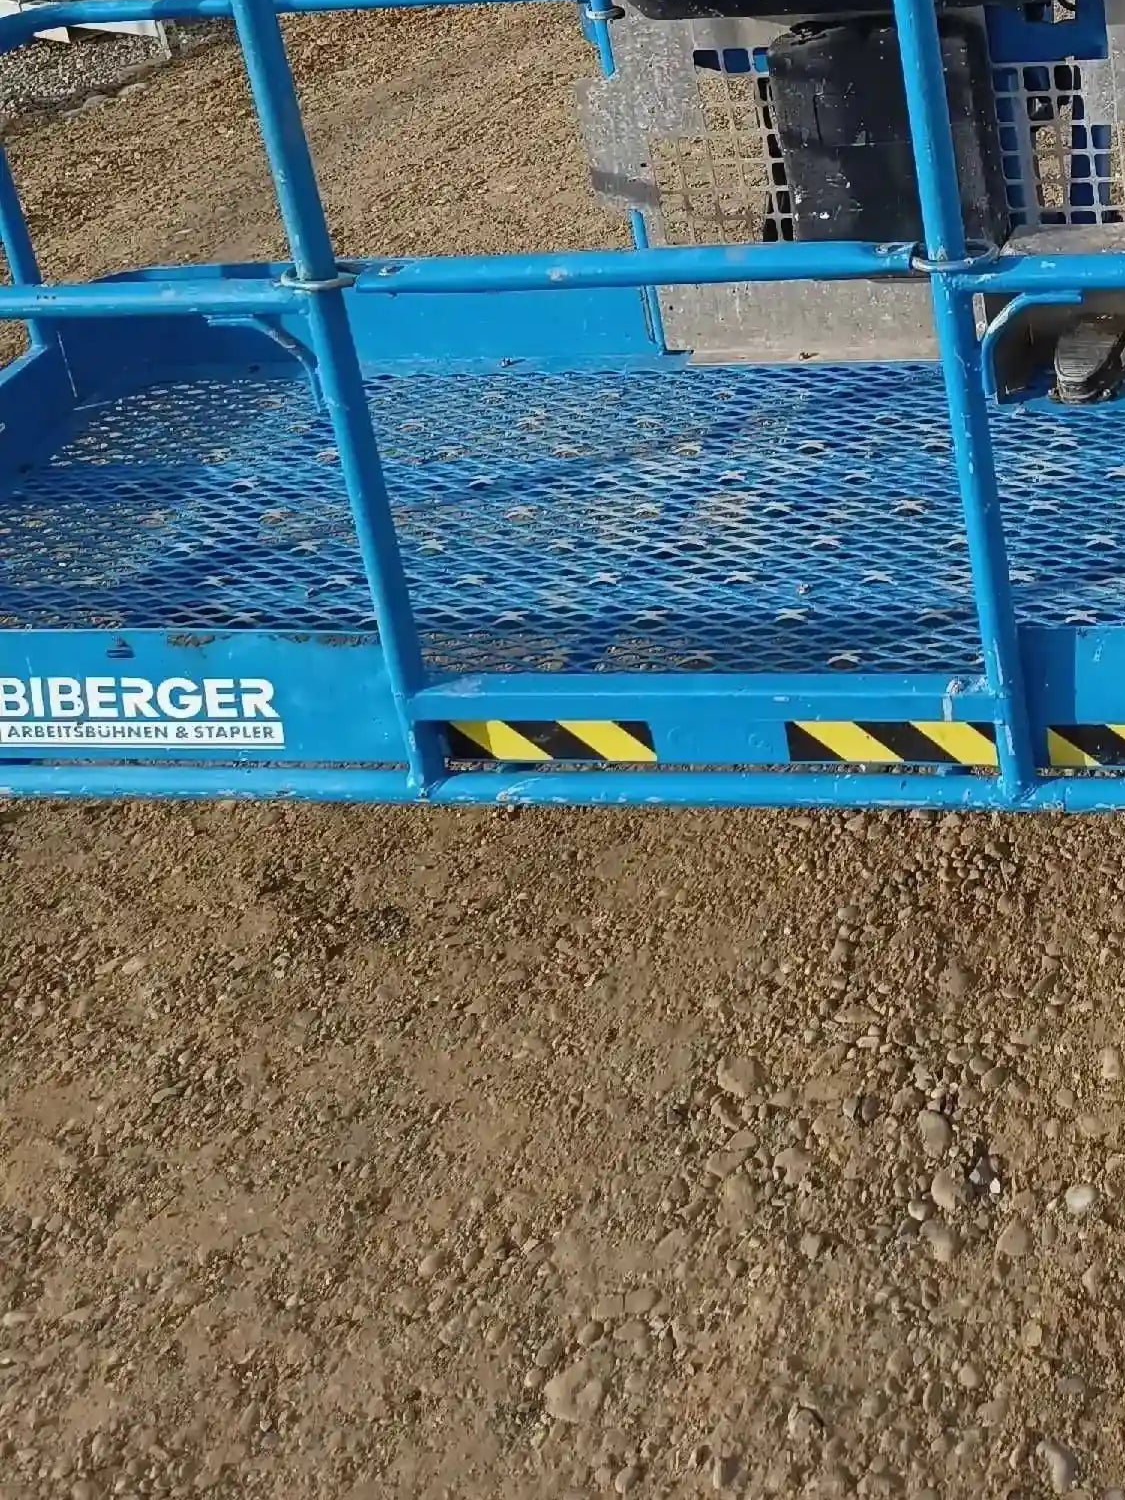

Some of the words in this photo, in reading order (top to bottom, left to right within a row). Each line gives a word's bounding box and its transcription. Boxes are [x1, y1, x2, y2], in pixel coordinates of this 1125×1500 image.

[0, 676, 281, 719] BIBERGER
[7, 724, 169, 739] ARBEITSBÜHNEN
[174, 725, 190, 739] &
[194, 725, 276, 740] STAPLER
